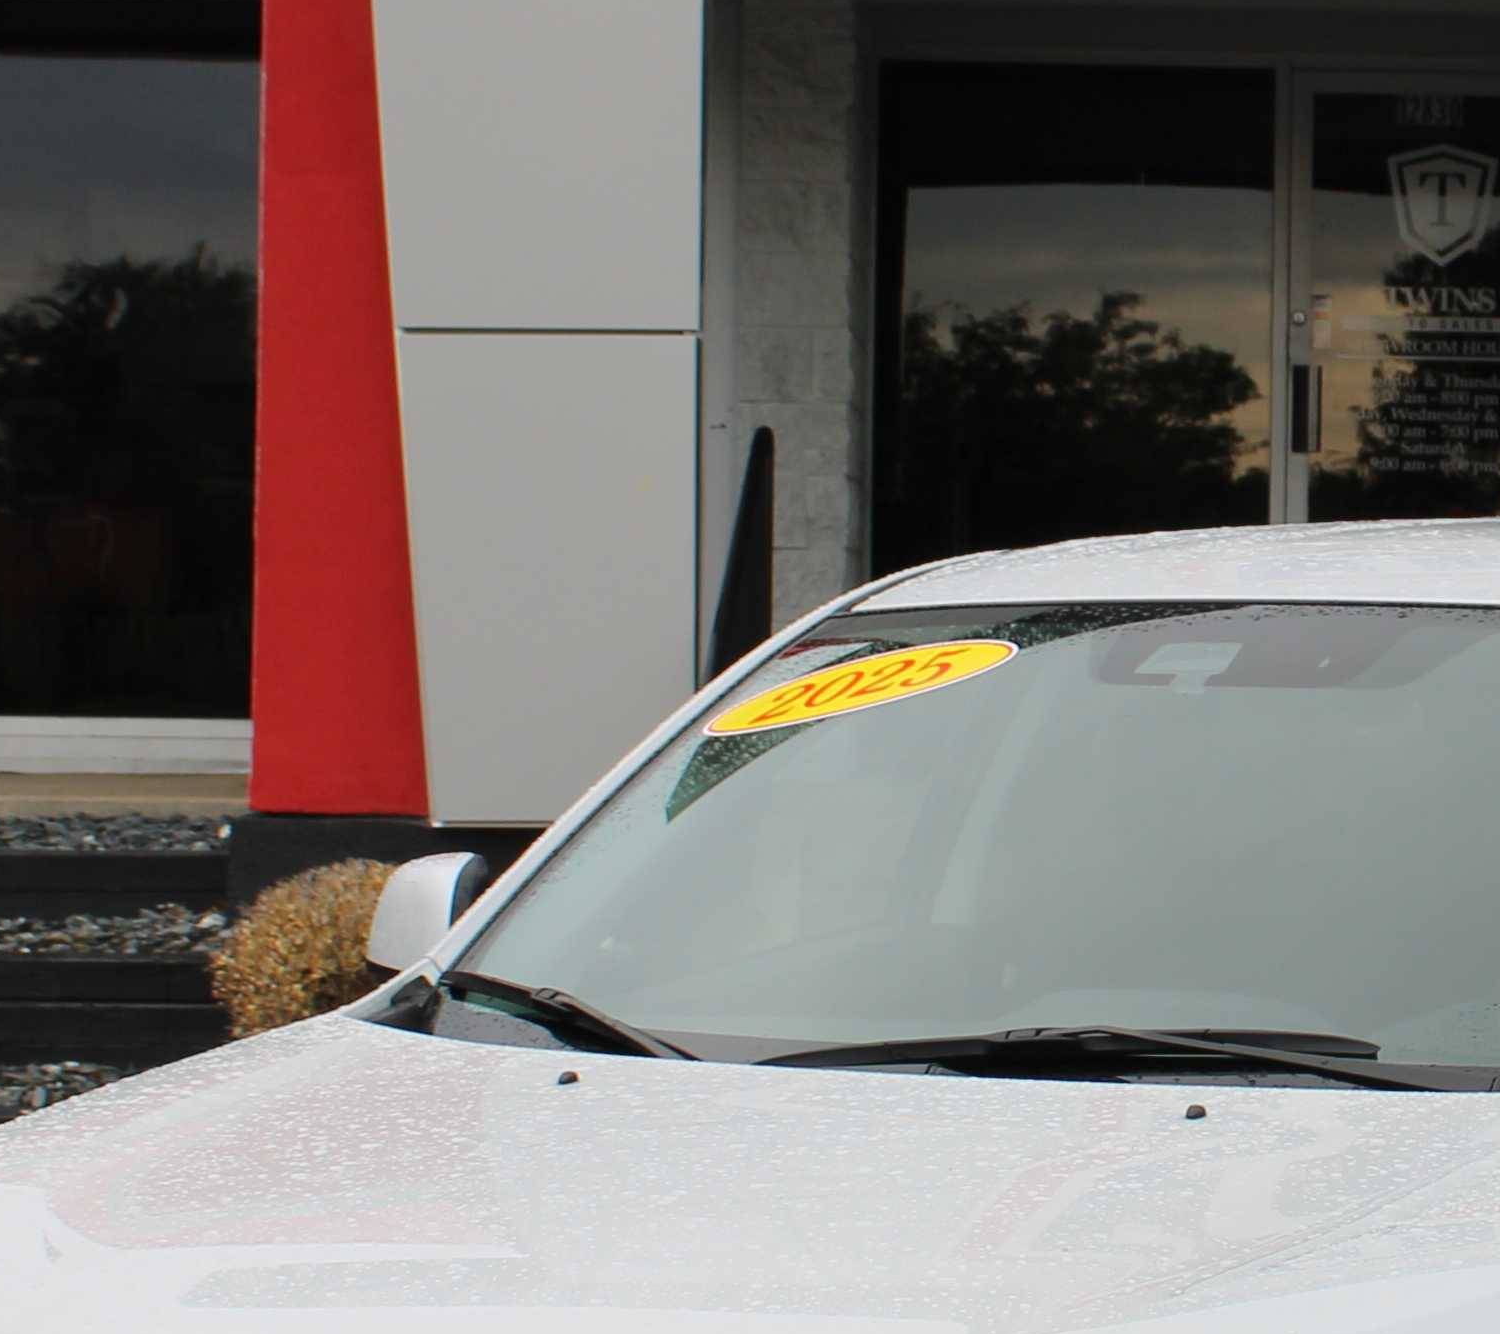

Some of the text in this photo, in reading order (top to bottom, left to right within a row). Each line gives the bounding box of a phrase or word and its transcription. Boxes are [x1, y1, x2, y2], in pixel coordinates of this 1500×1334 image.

[1418, 170, 1467, 227] T
[1385, 286, 1497, 314] TWINS
[1473, 394, 1500, 408] pm
[1391, 407, 1479, 425] Wednesday
[1473, 427, 1500, 443] pm
[749, 648, 971, 724] 2025
